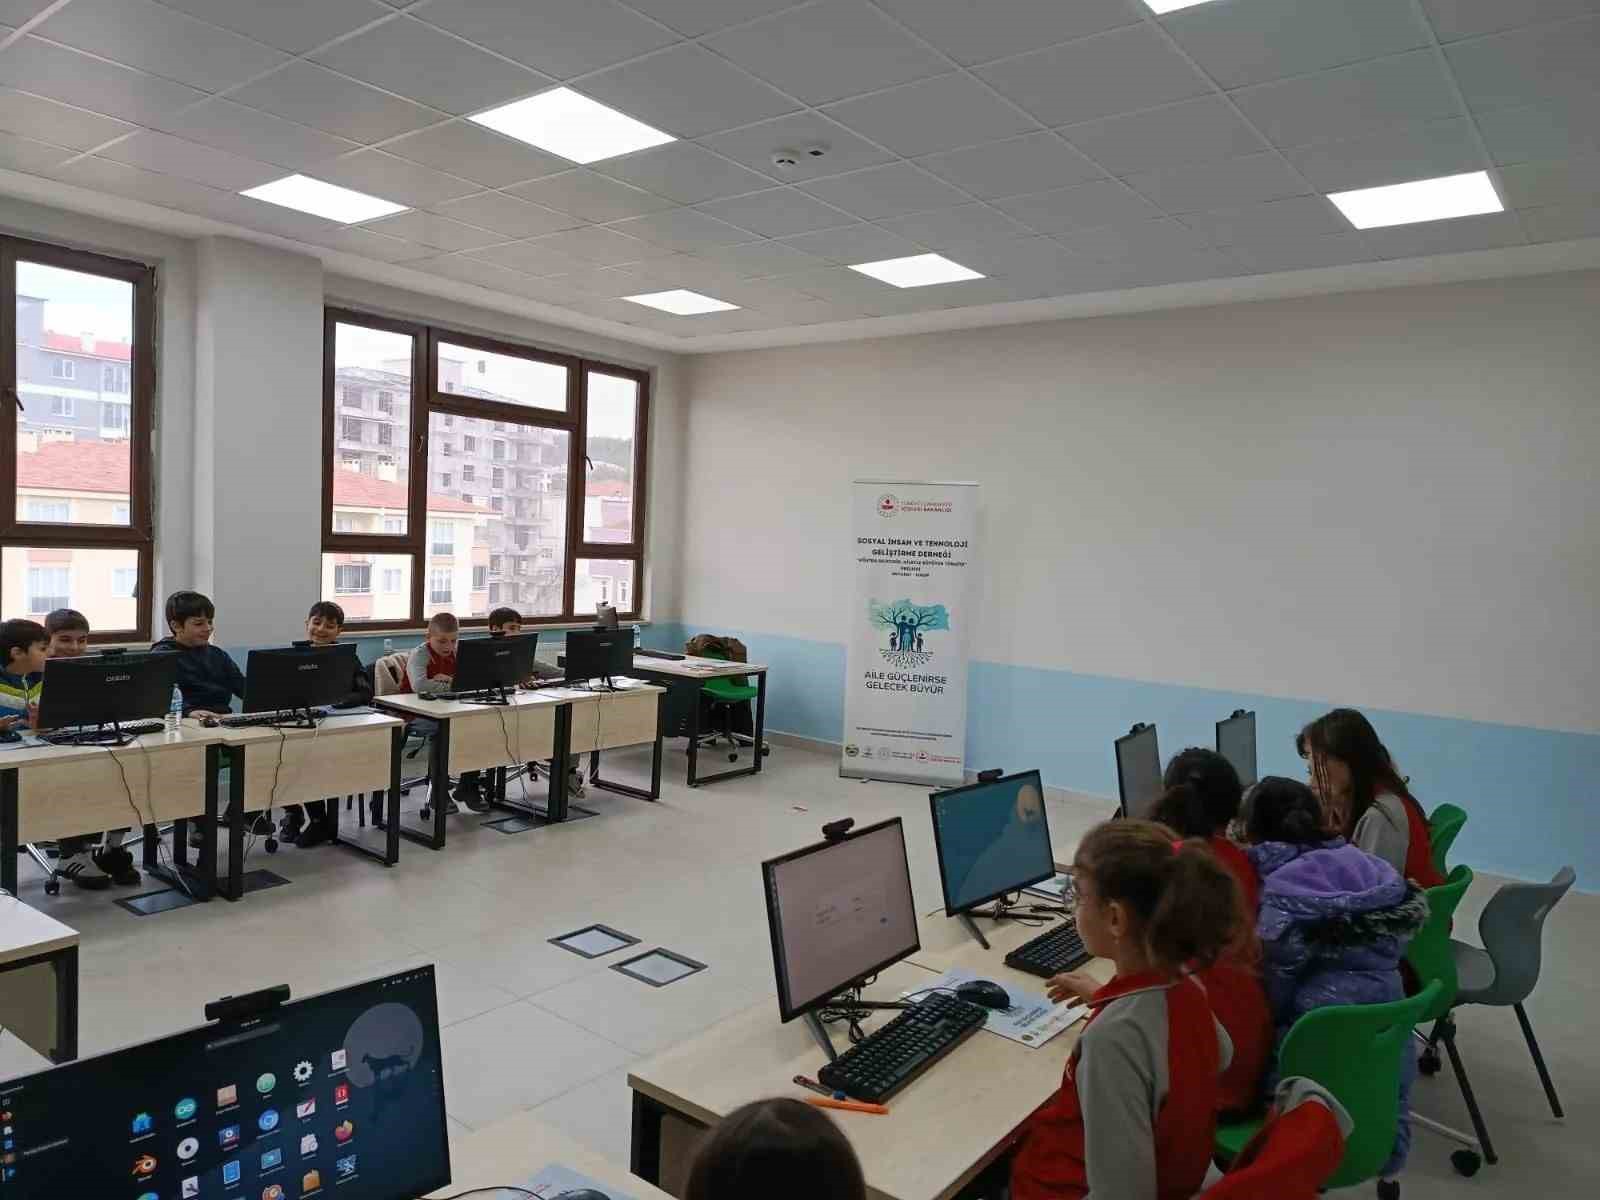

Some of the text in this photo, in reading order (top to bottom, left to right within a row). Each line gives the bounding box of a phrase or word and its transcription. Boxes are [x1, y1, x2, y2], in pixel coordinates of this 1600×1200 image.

[857, 537, 886, 545] SOSYAL
[872, 548, 951, 559] GELİŞTİRME DERNEĞİ
[864, 671, 947, 685] AİLE GÜÇLENİRSE
[865, 681, 943, 695] GELECEK BÜYÜR
